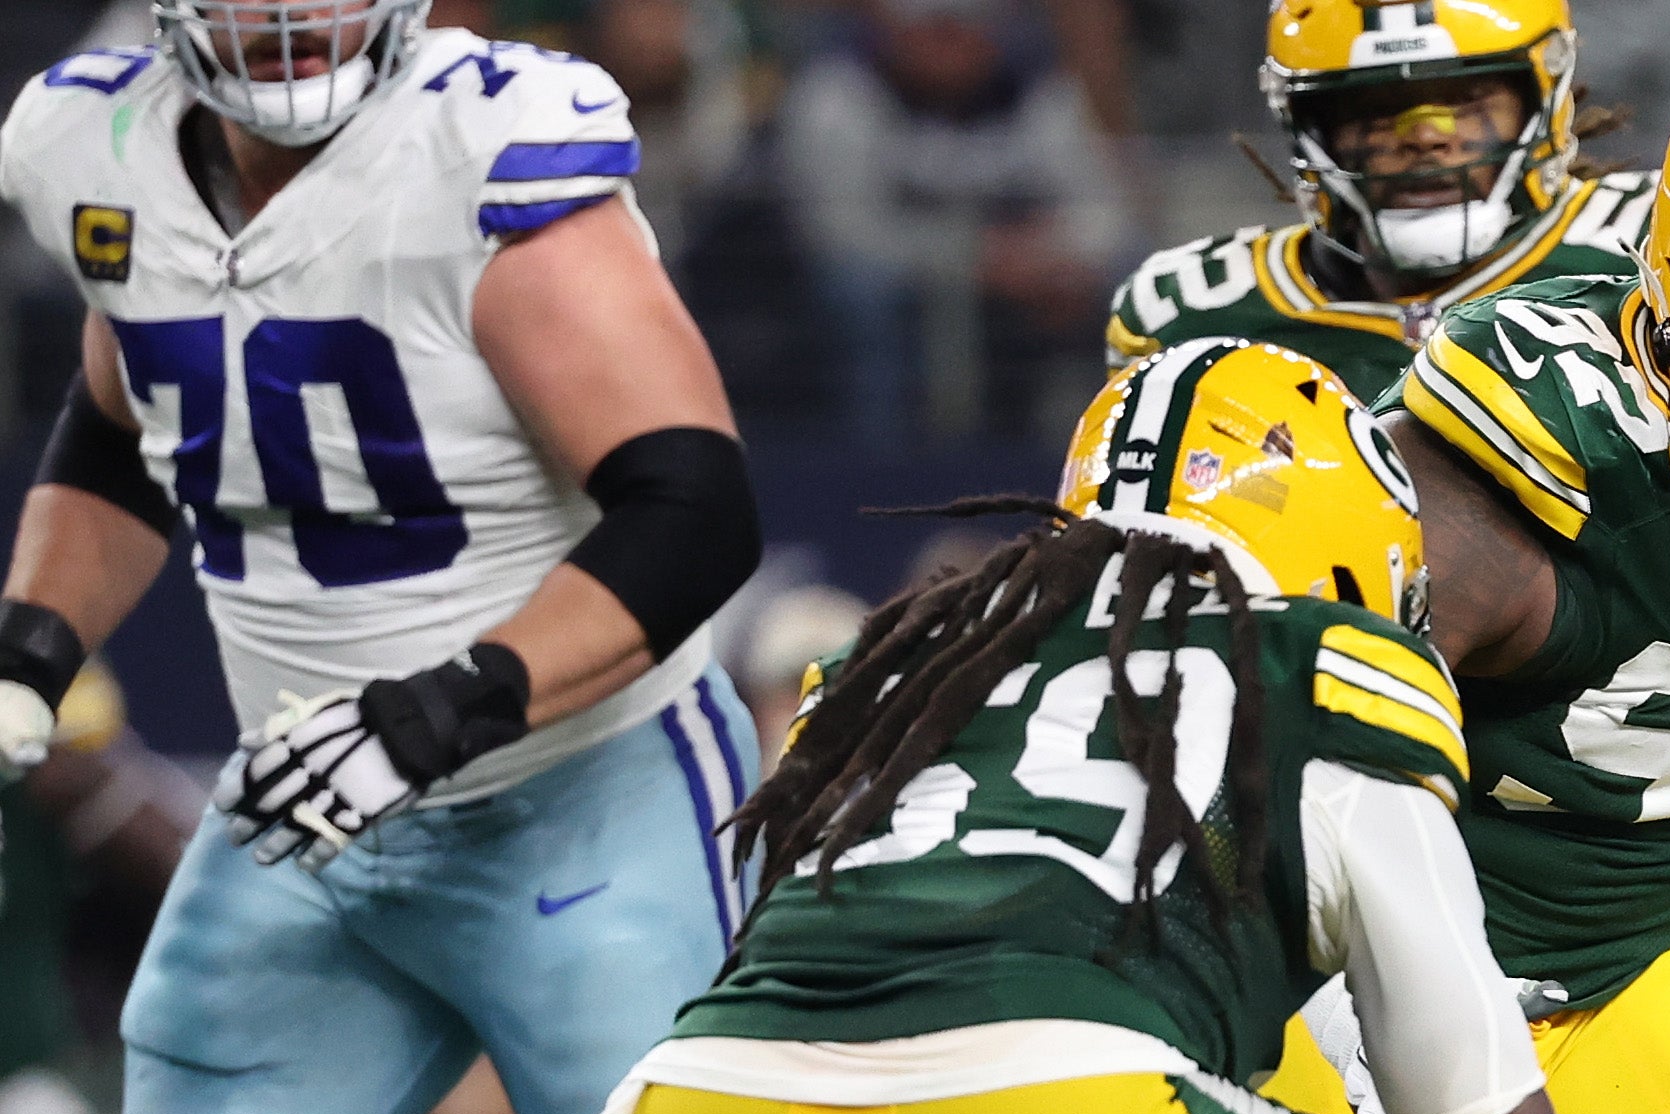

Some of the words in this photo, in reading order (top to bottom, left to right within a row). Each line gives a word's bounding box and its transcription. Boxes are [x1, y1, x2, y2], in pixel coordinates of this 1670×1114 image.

[75, 207, 130, 264] C
[109, 312, 469, 588] 70
[1116, 450, 1156, 472] MLK
